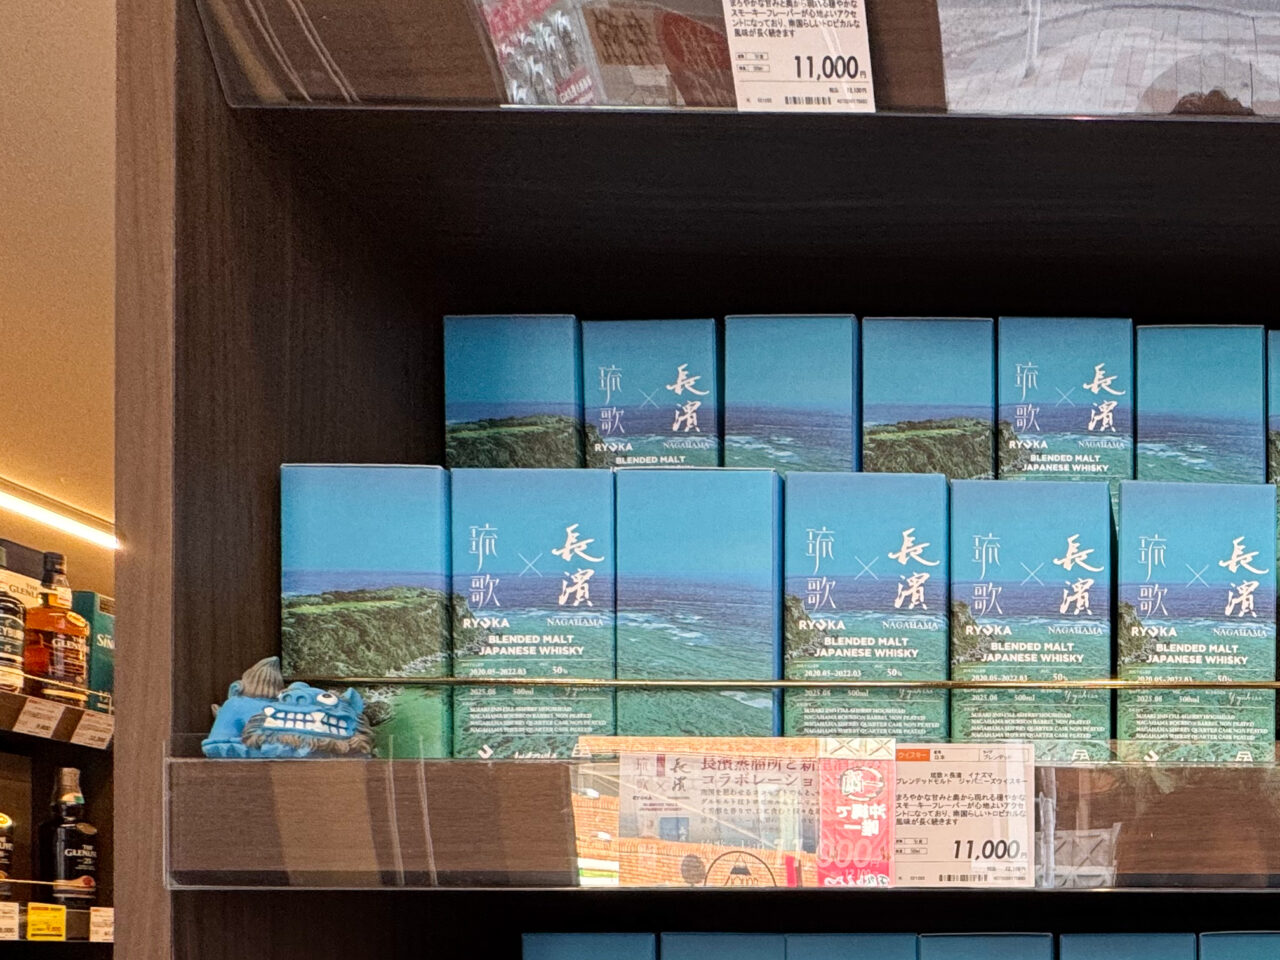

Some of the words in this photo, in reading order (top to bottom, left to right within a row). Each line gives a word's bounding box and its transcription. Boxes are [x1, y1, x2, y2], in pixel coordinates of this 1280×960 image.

[667, 363, 709, 433] 長濱
[1083, 362, 1126, 432] 長濱
[552, 522, 604, 607] 長濱
[888, 526, 940, 610] 長濱
[1053, 533, 1104, 616] 長濱
[1219, 535, 1269, 618] 長濱
[478, 646, 536, 657] JAPANESE
[540, 646, 585, 655] WHISKY
[488, 634, 540, 644] BLENDED
[543, 634, 574, 644] MALT
[1146, 655, 1202, 665] JAPANESE
[1205, 656, 1249, 664] WHISKY
[1156, 643, 1206, 653] BLENDED
[1208, 644, 1239, 654] MALT
